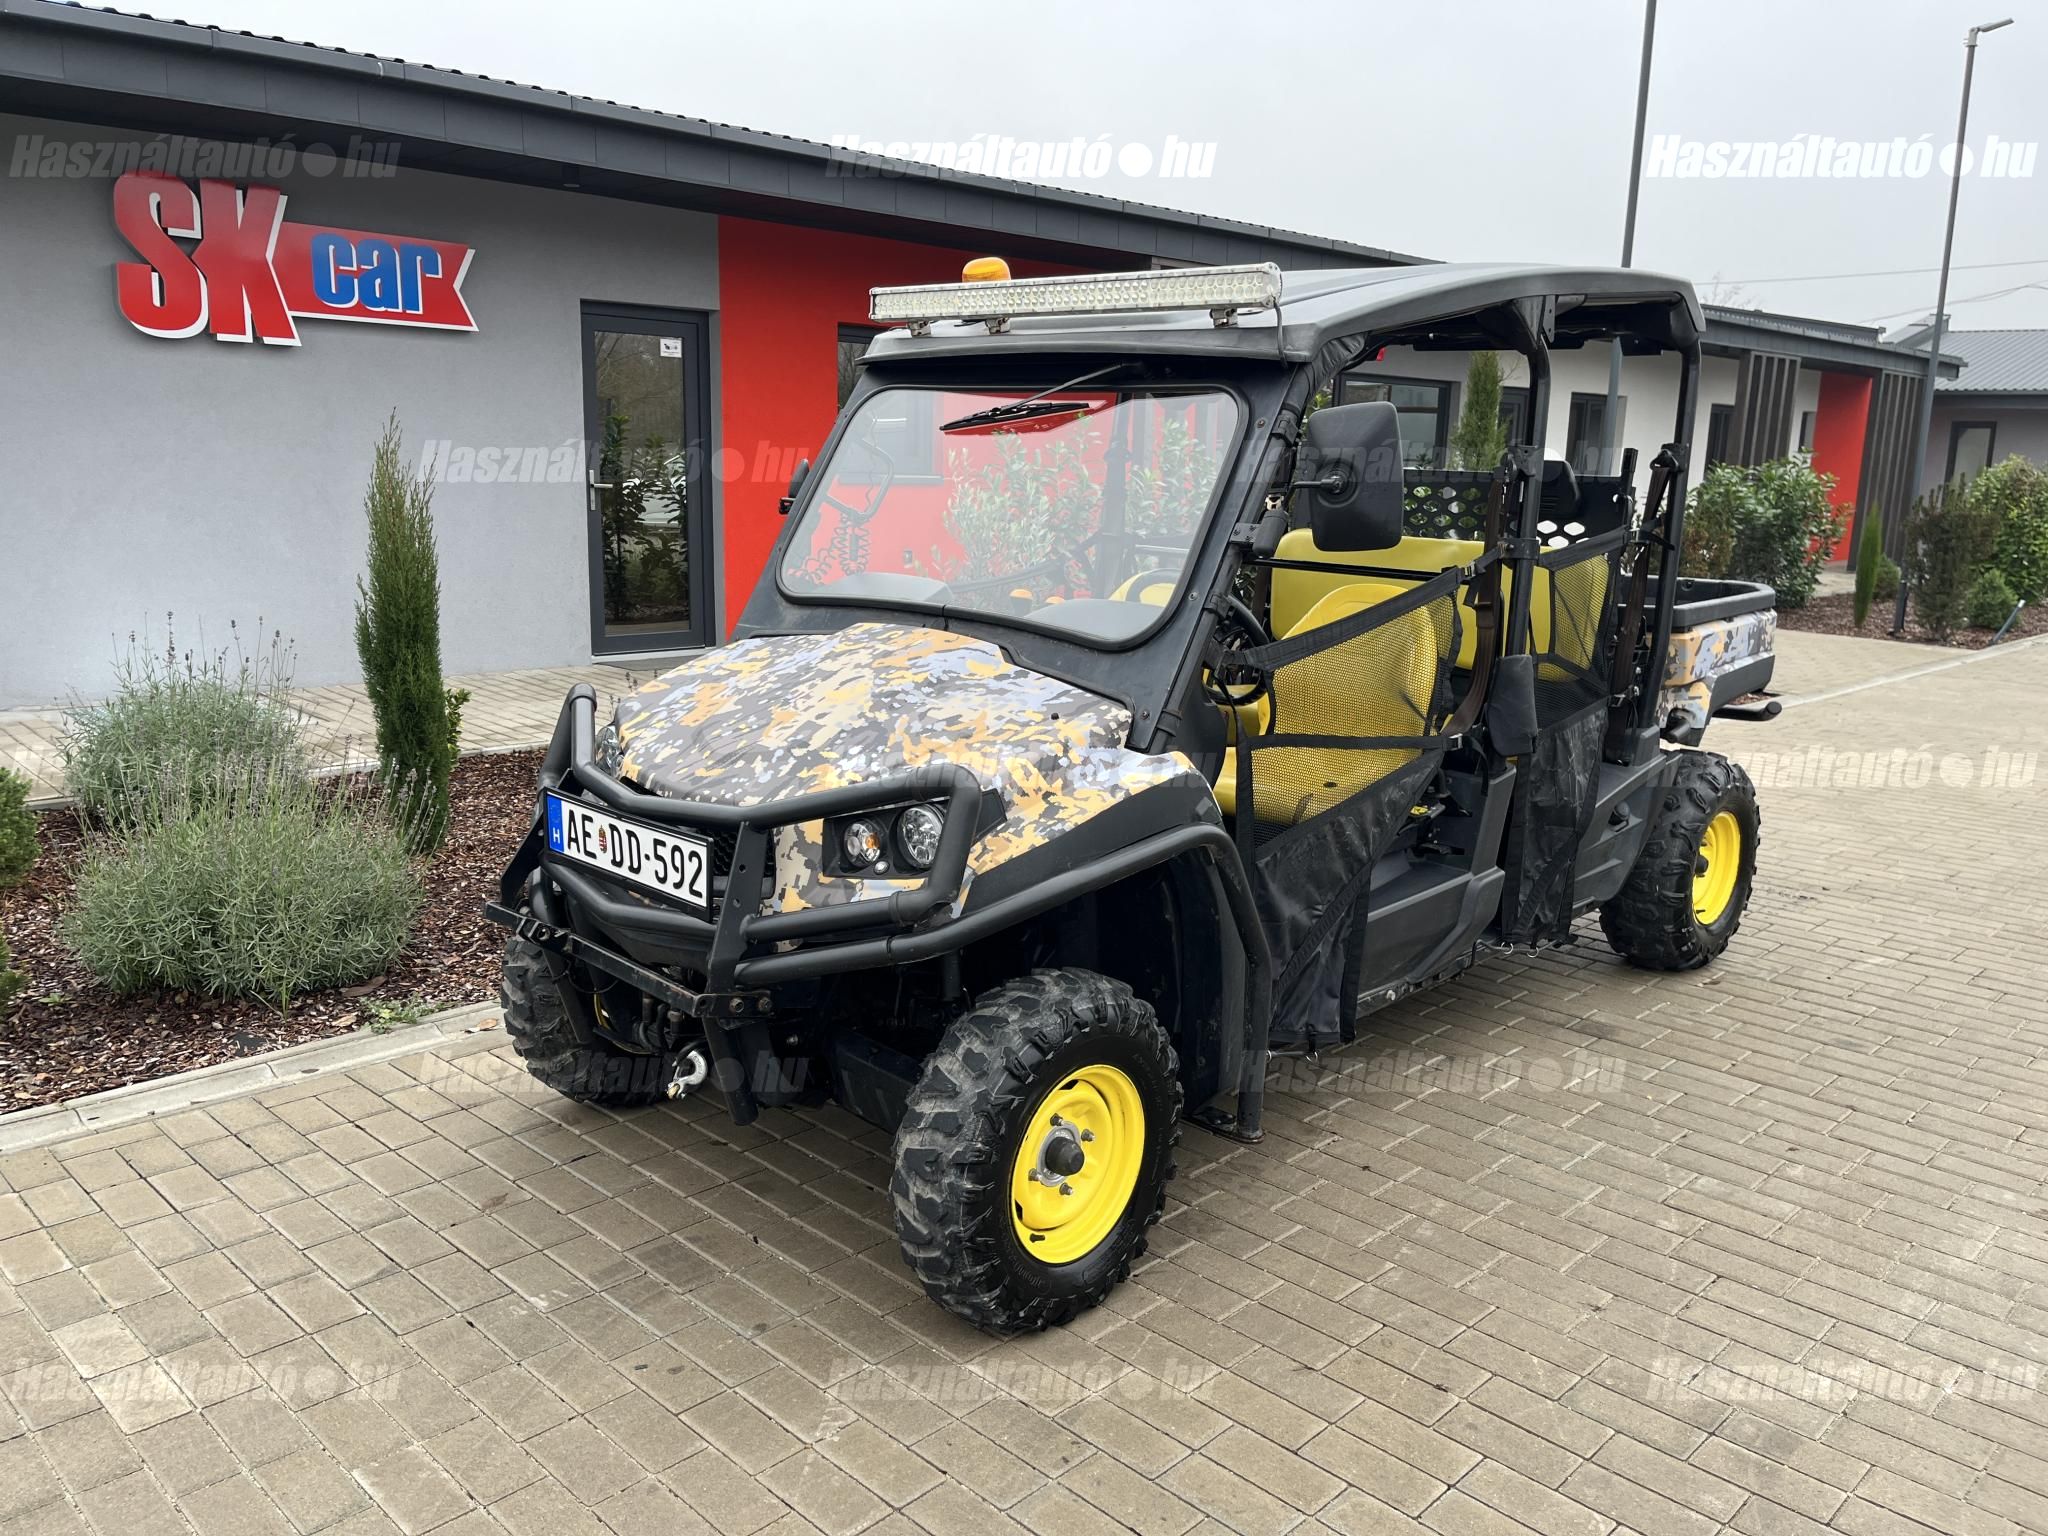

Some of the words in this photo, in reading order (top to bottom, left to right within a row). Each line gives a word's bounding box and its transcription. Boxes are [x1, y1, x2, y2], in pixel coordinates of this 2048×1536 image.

[113, 171, 301, 346] SK
[311, 233, 442, 314] car
[553, 827, 560, 844] H
[567, 809, 597, 859] AE
[609, 823, 703, 898] DD-592
